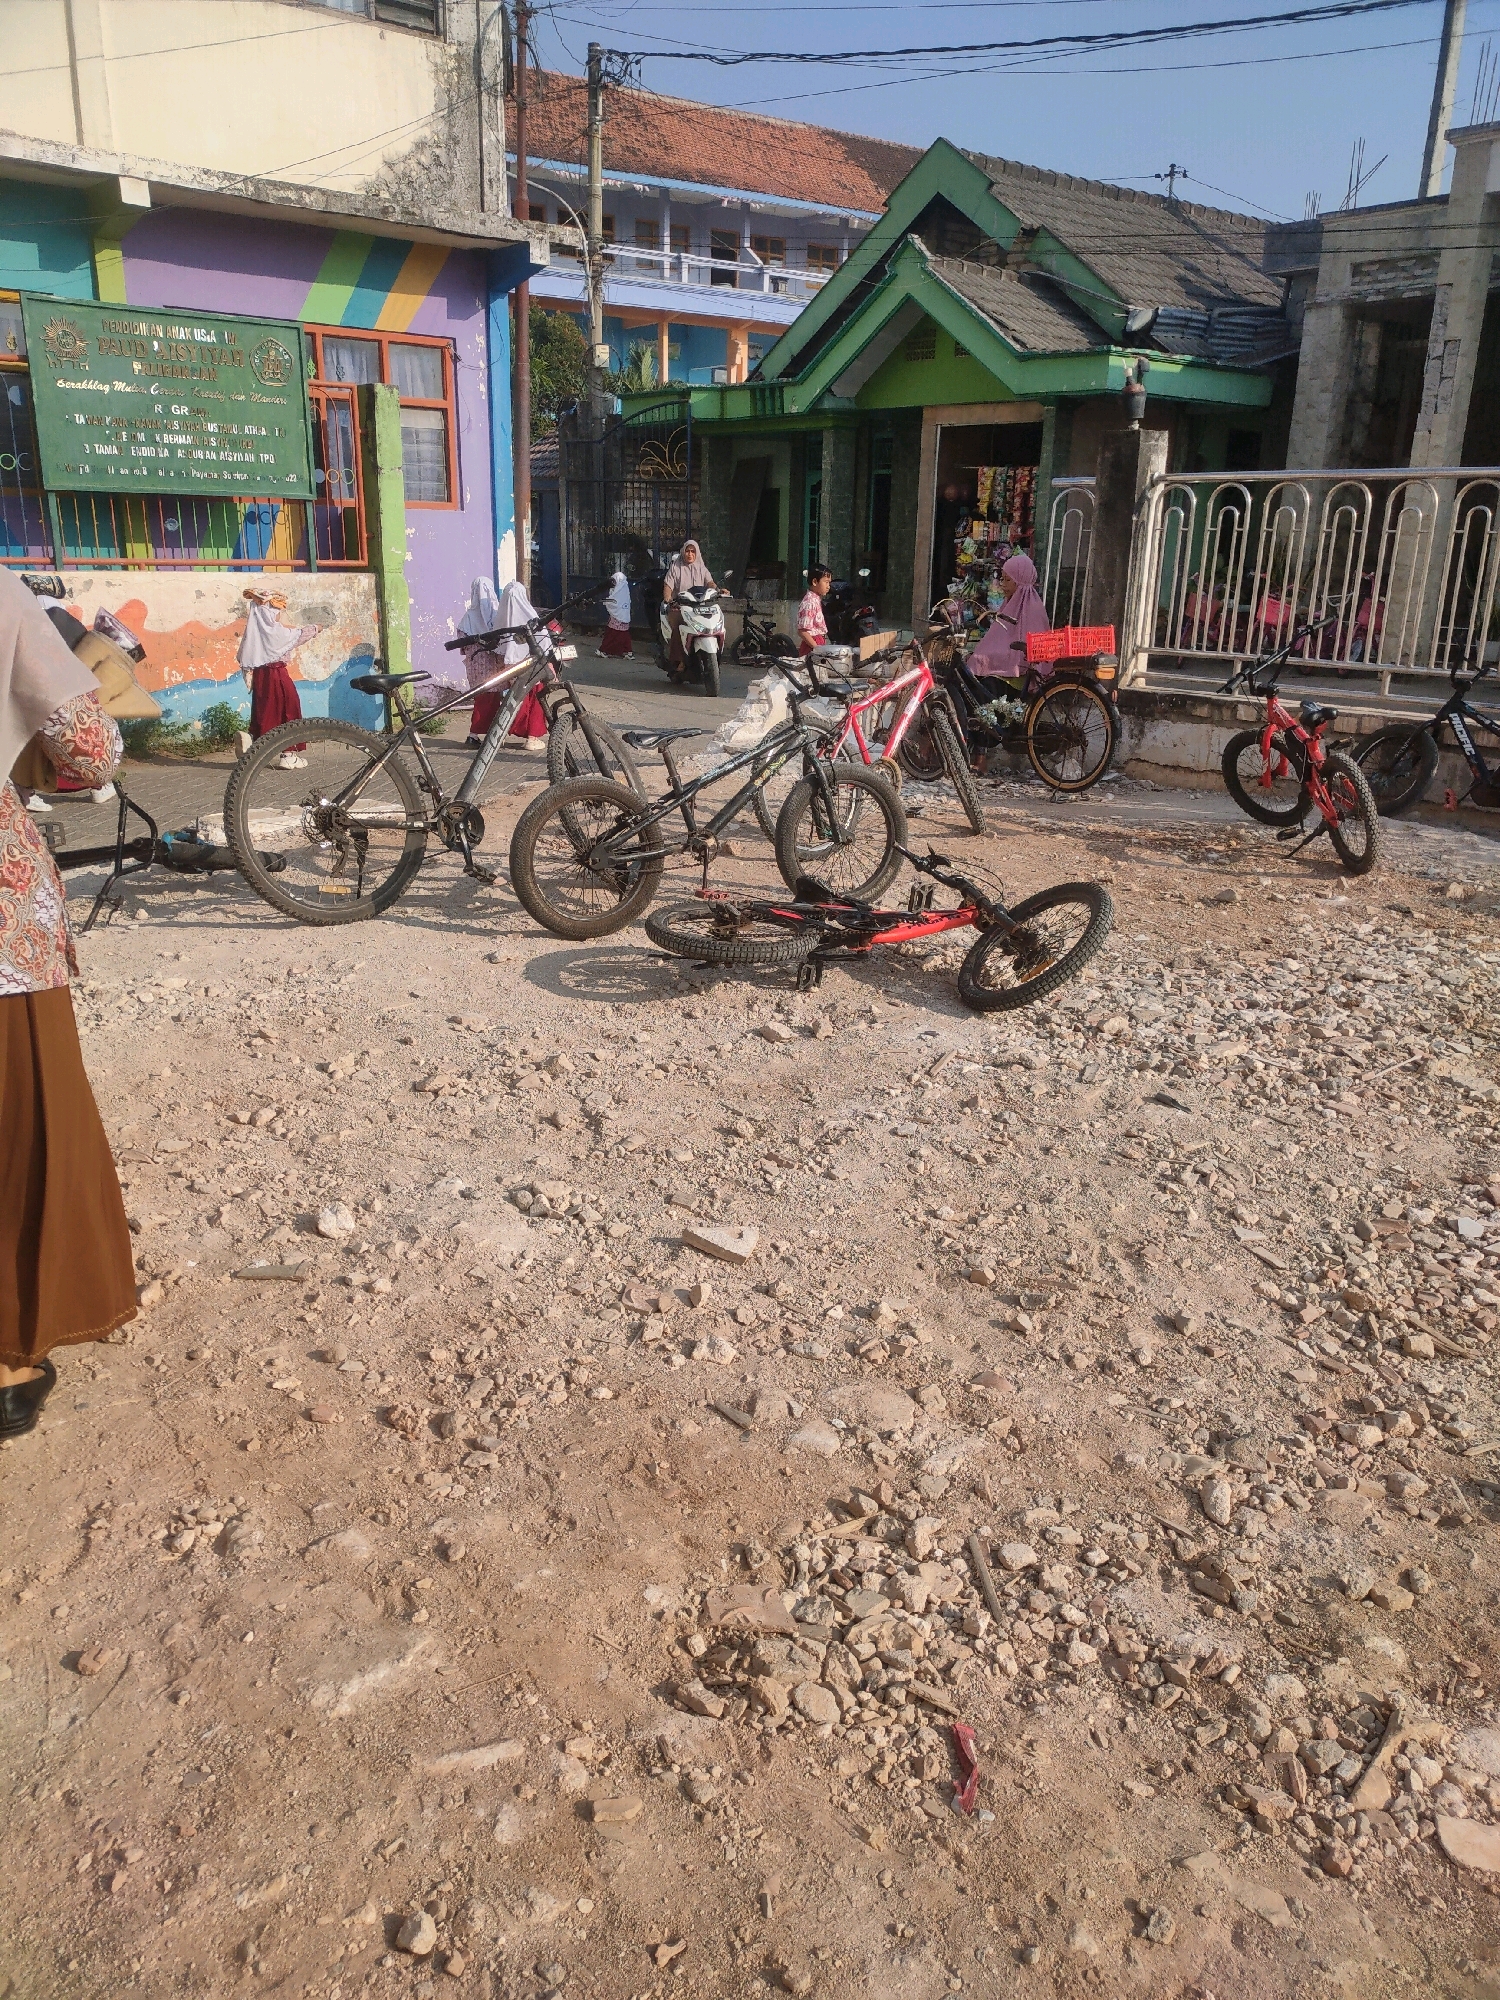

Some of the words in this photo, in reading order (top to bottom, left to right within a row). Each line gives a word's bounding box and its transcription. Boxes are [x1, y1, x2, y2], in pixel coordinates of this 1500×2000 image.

[166, 325, 192, 341] ANAK
[97, 336, 148, 358] PAUD
[1448, 712, 1476, 756] PACIFIC
